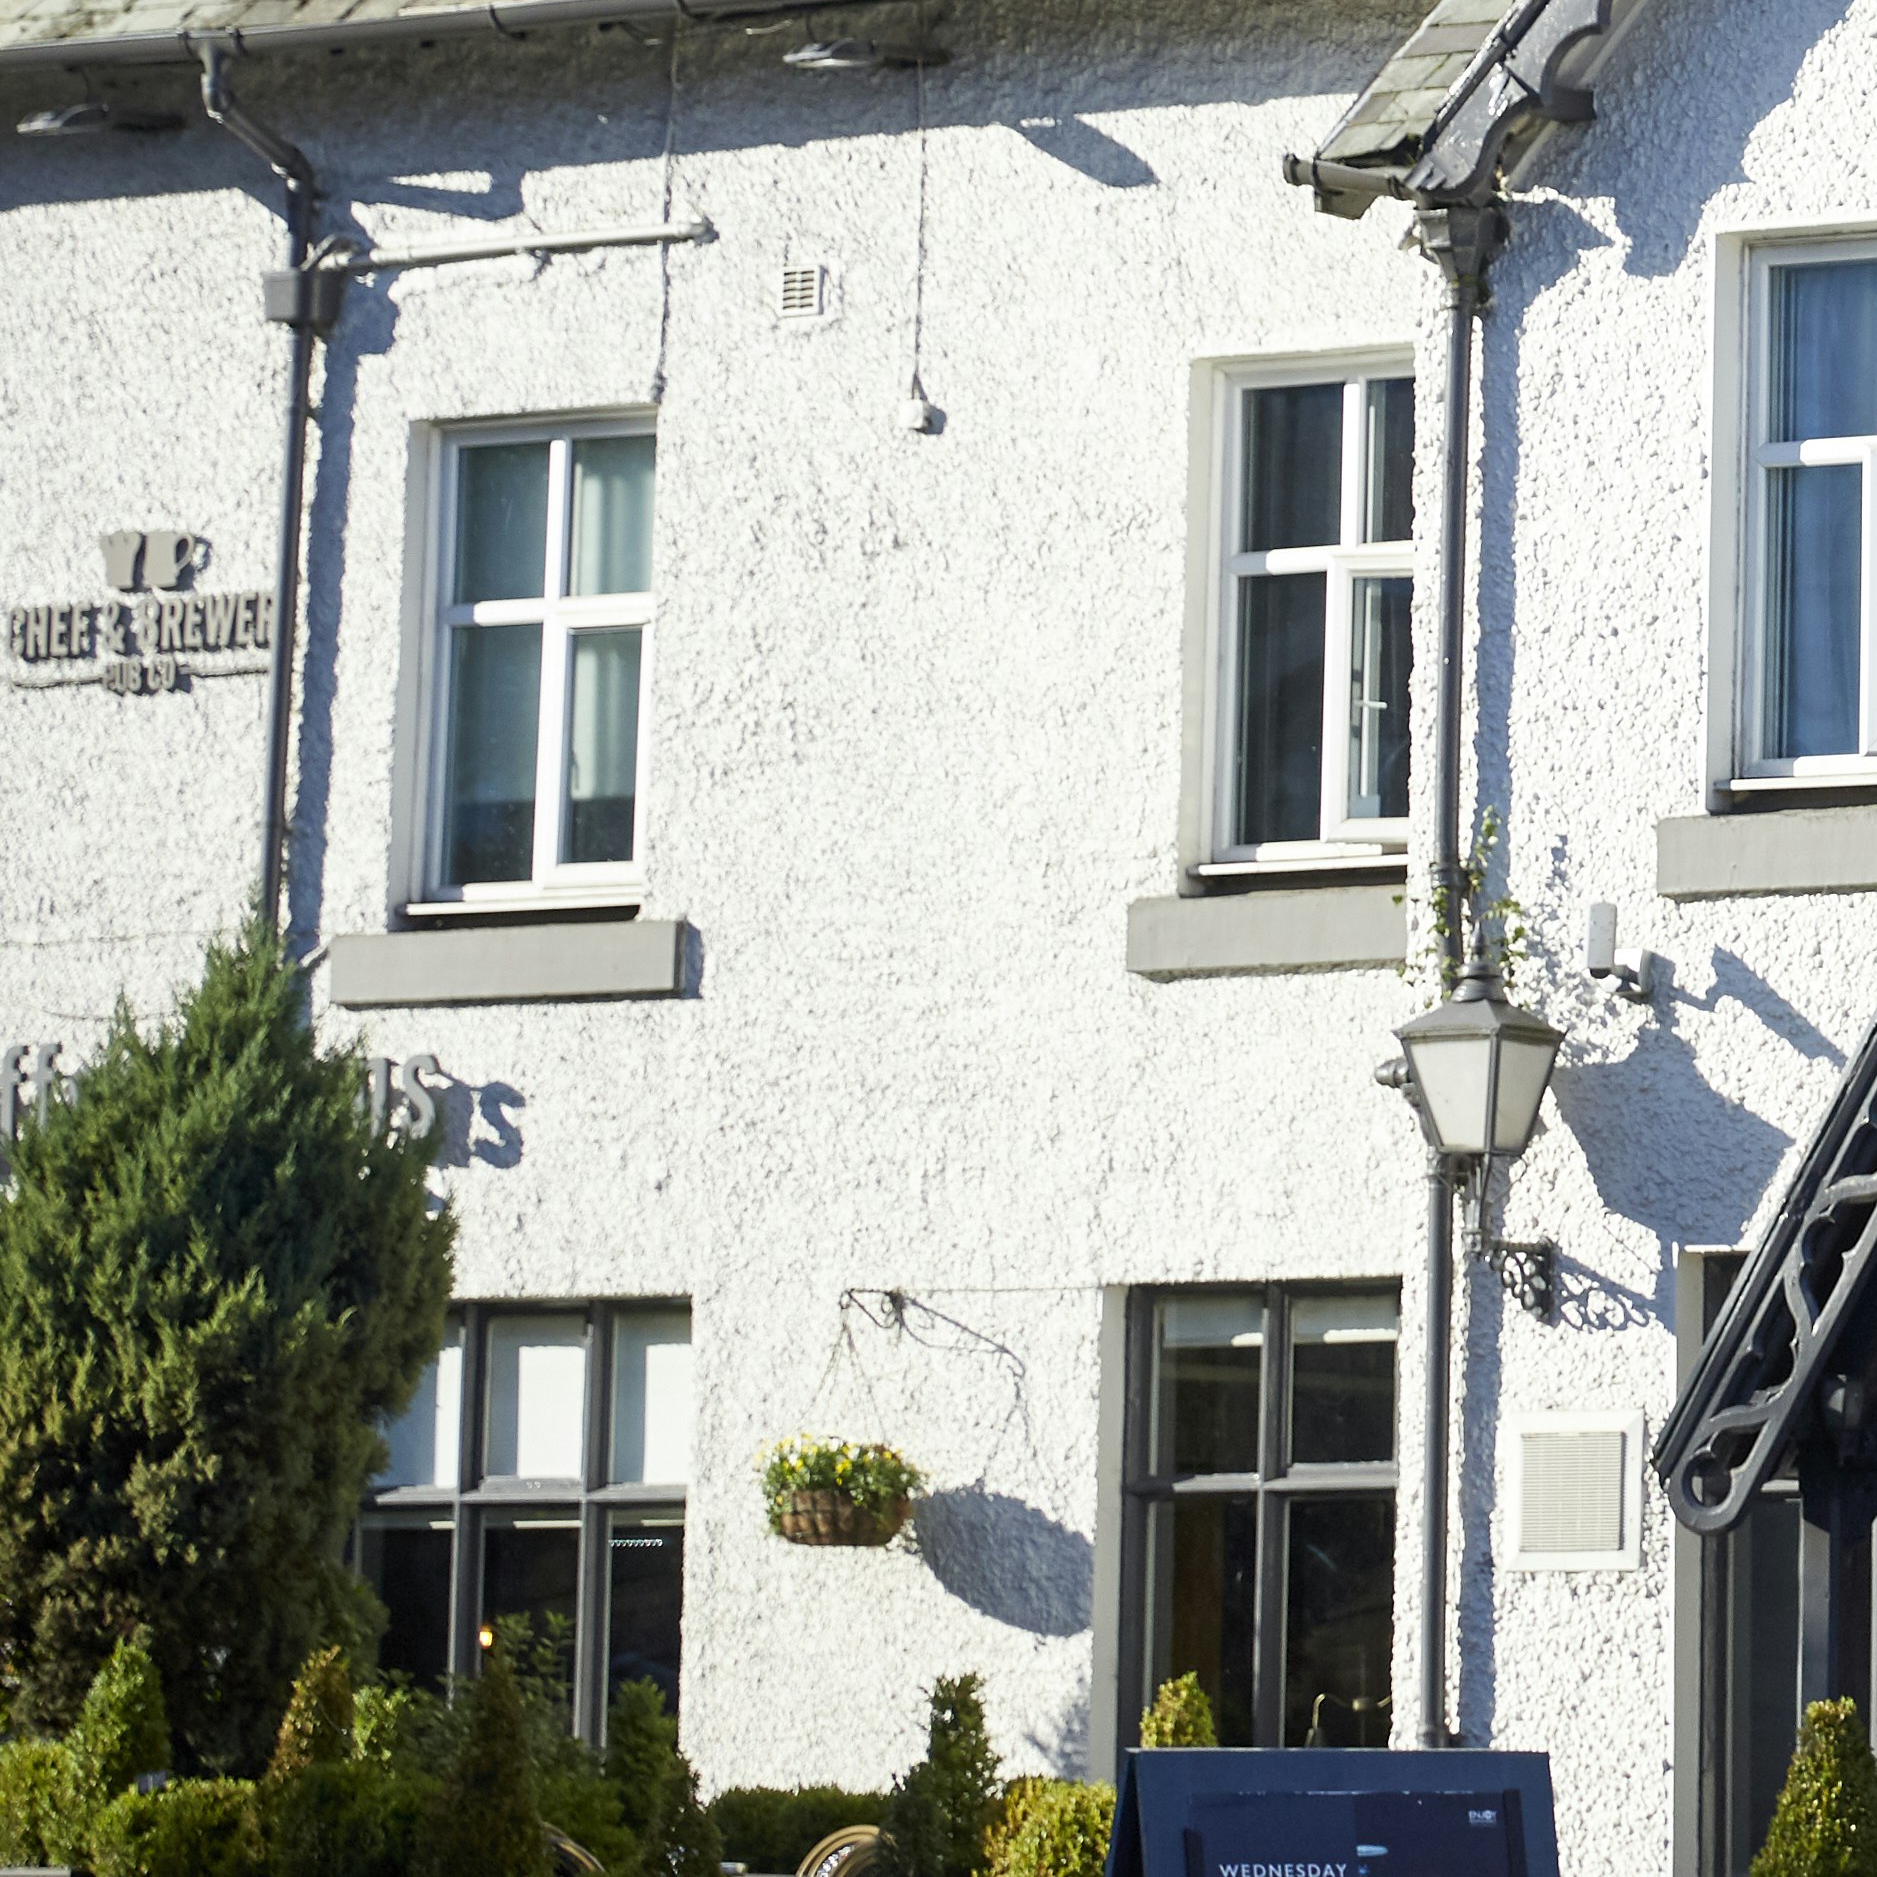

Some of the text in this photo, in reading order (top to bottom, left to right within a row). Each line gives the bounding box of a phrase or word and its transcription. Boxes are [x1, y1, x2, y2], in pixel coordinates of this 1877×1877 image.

[10, 600, 92, 659] CHEF
[102, 601, 125, 653] &
[102, 653, 176, 693] PUB CO
[1218, 1862, 1347, 1877] WEDNESDAY
